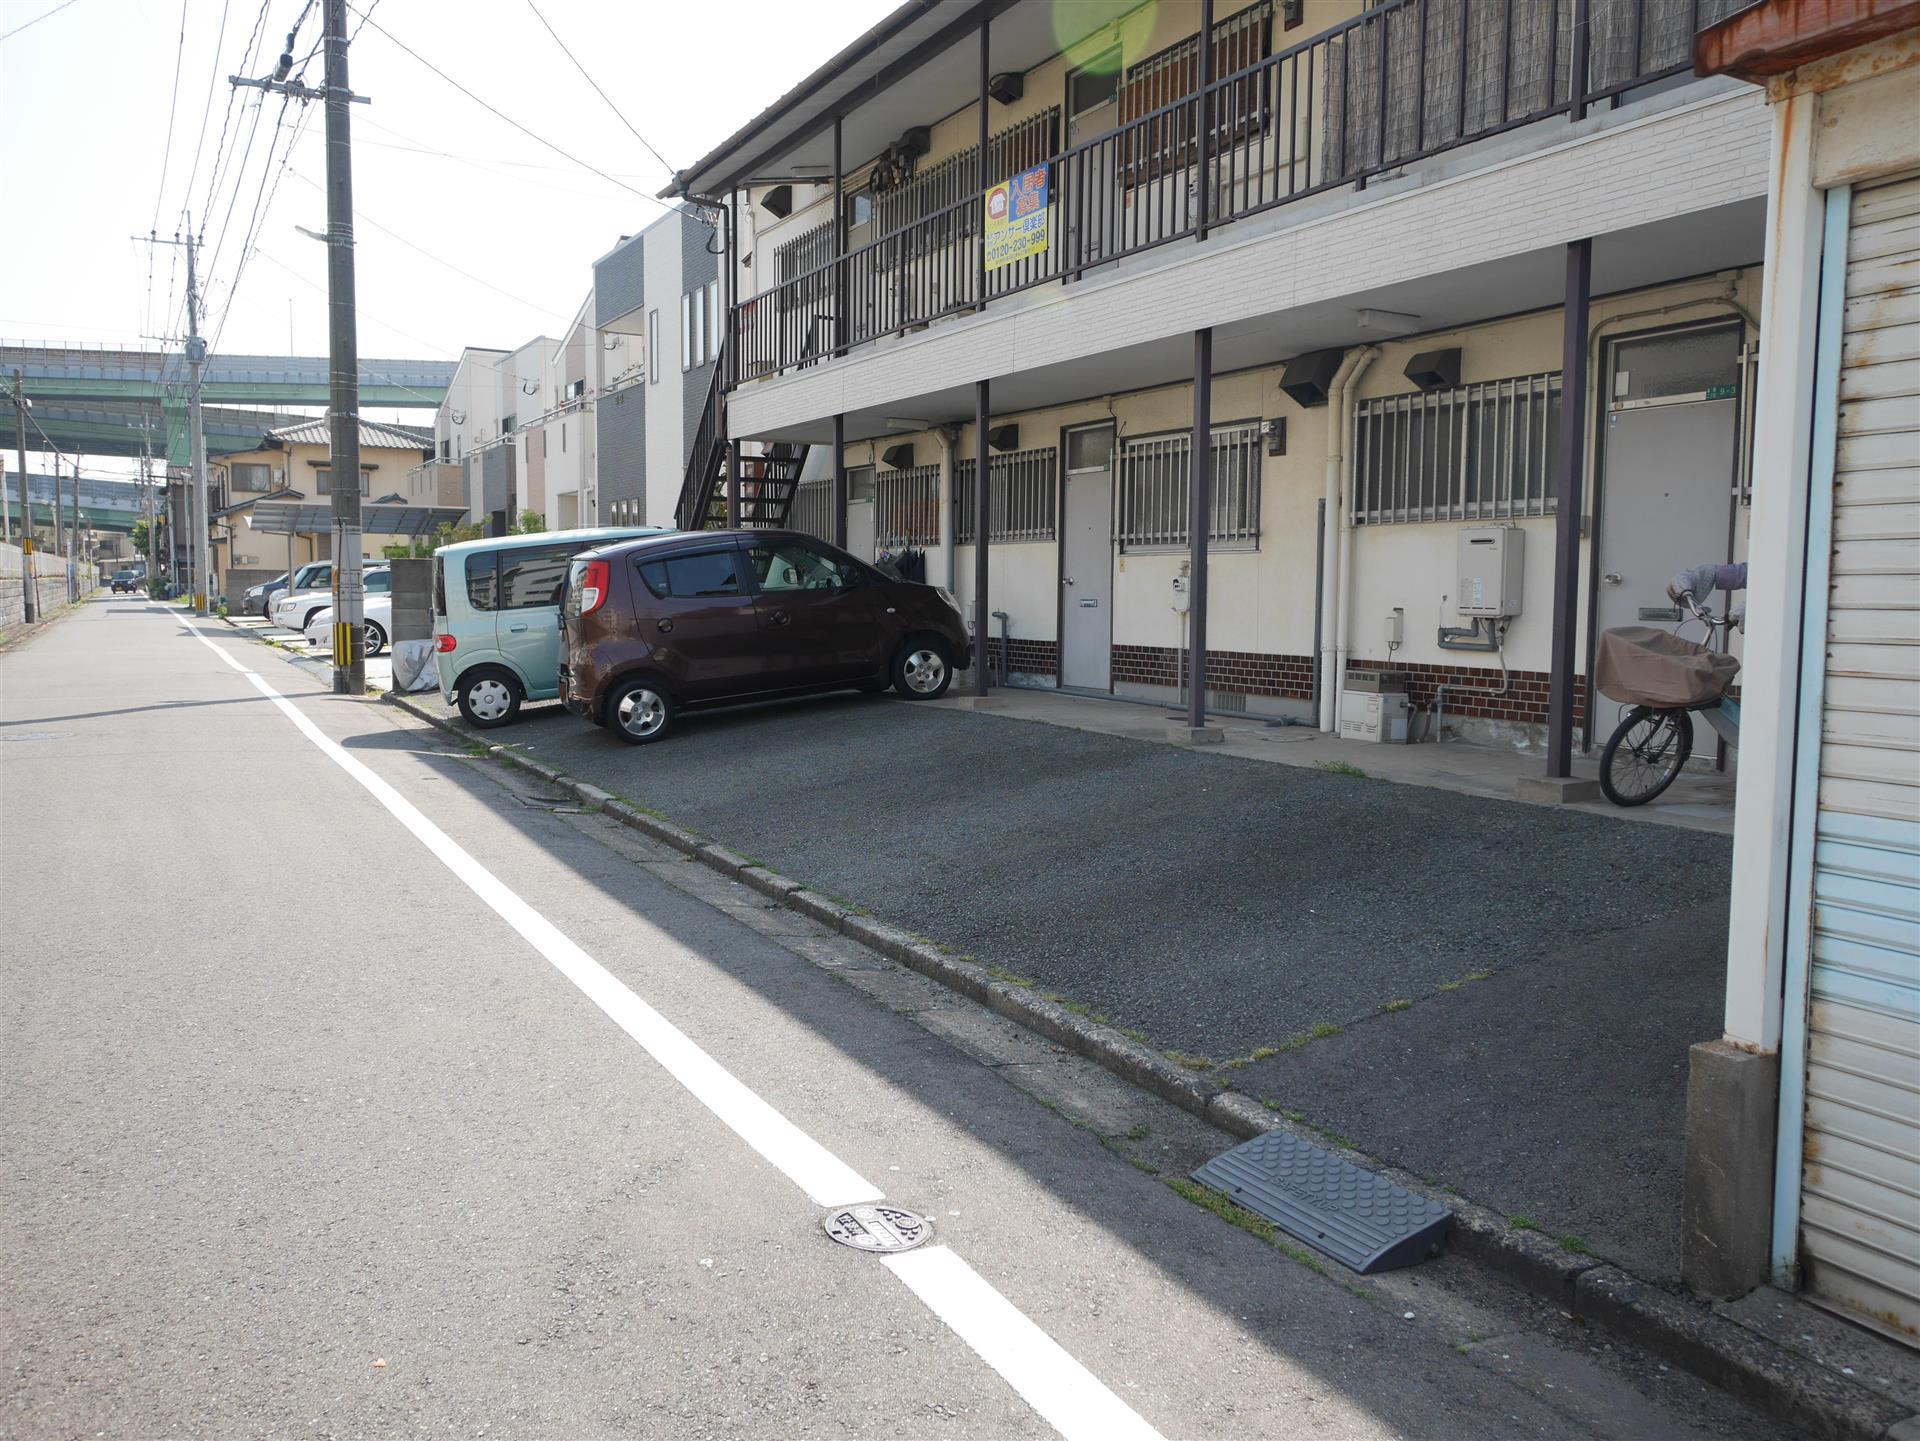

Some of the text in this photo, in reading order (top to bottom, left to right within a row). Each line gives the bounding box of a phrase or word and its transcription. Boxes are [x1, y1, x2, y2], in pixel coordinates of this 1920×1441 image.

[1010, 168, 1046, 201] 入居者
[1016, 191, 1039, 217] 募集
[991, 229, 1046, 260] 0120-230-999
[993, 211, 1046, 247] アンサー倶楽部
